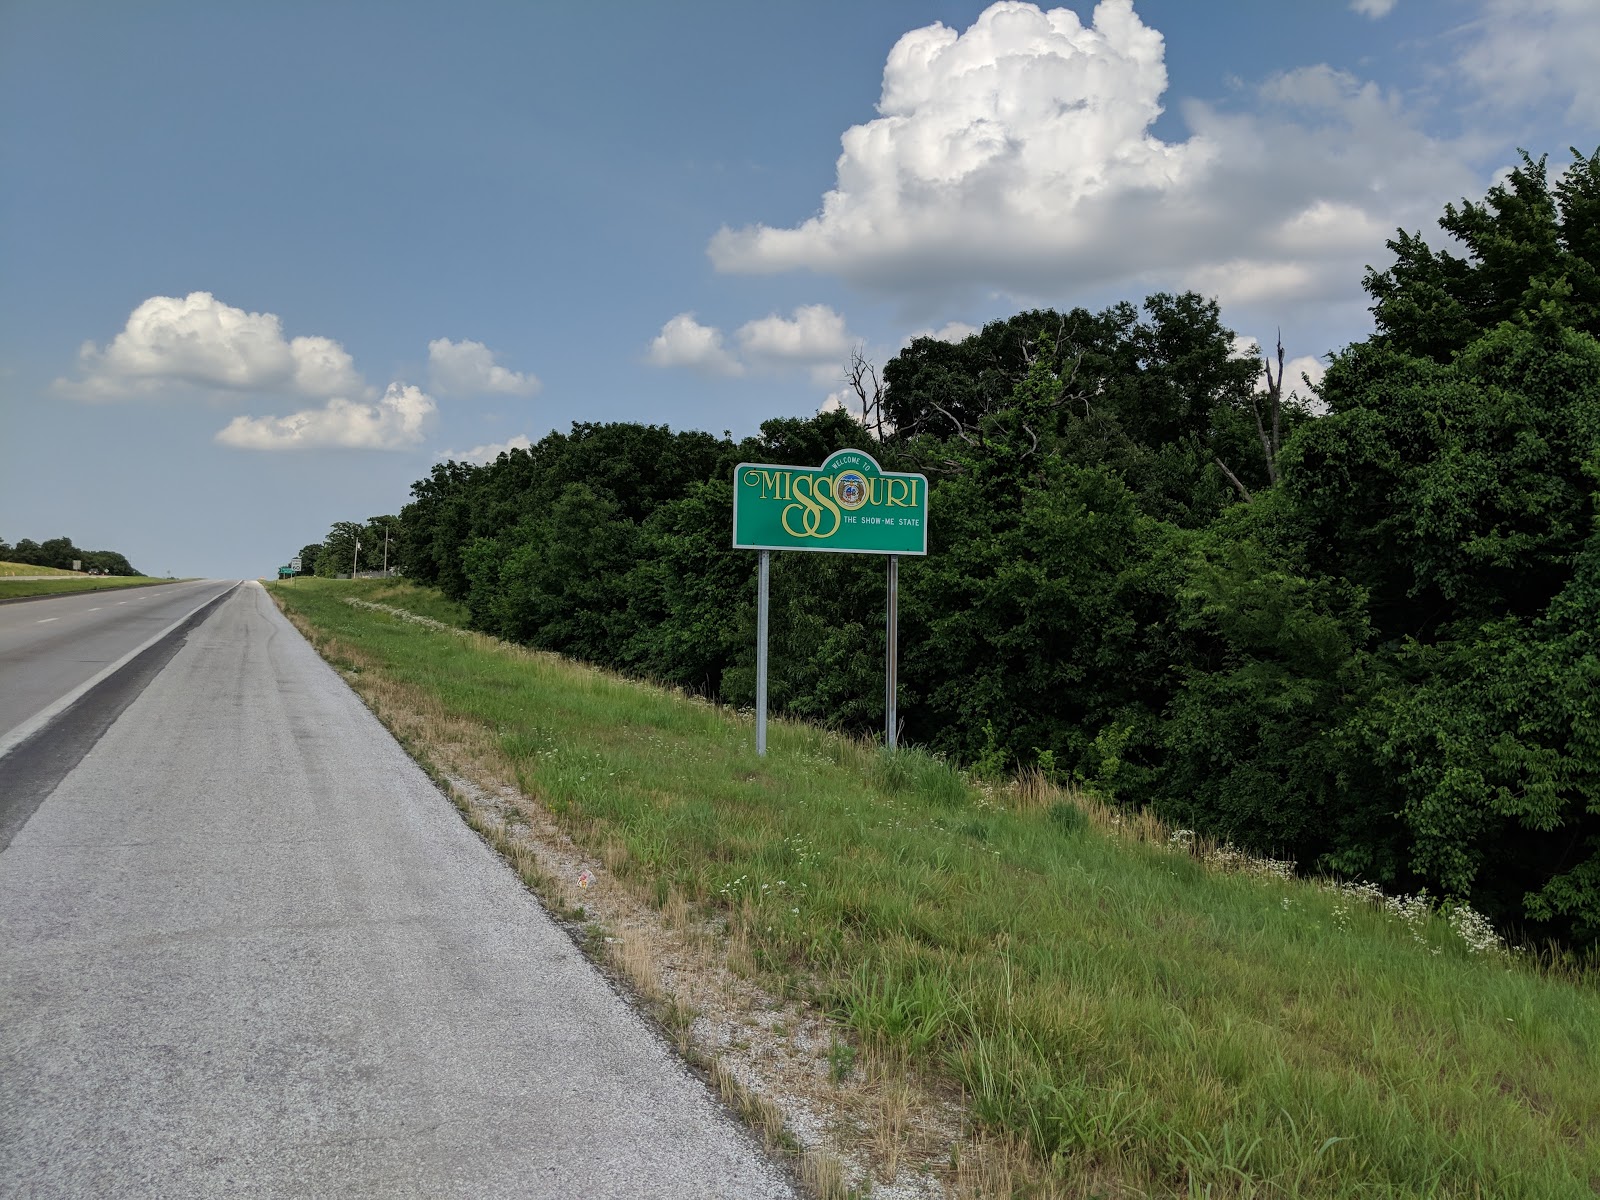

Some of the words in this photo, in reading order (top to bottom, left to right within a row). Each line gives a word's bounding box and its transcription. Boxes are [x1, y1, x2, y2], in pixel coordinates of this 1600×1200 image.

[831, 456, 861, 469] WELCOME
[862, 462, 871, 472] TO
[743, 469, 918, 538] MISSOURI
[844, 515, 857, 524] THE
[861, 516, 895, 526] SHOW-ME
[899, 518, 920, 526] STATE
